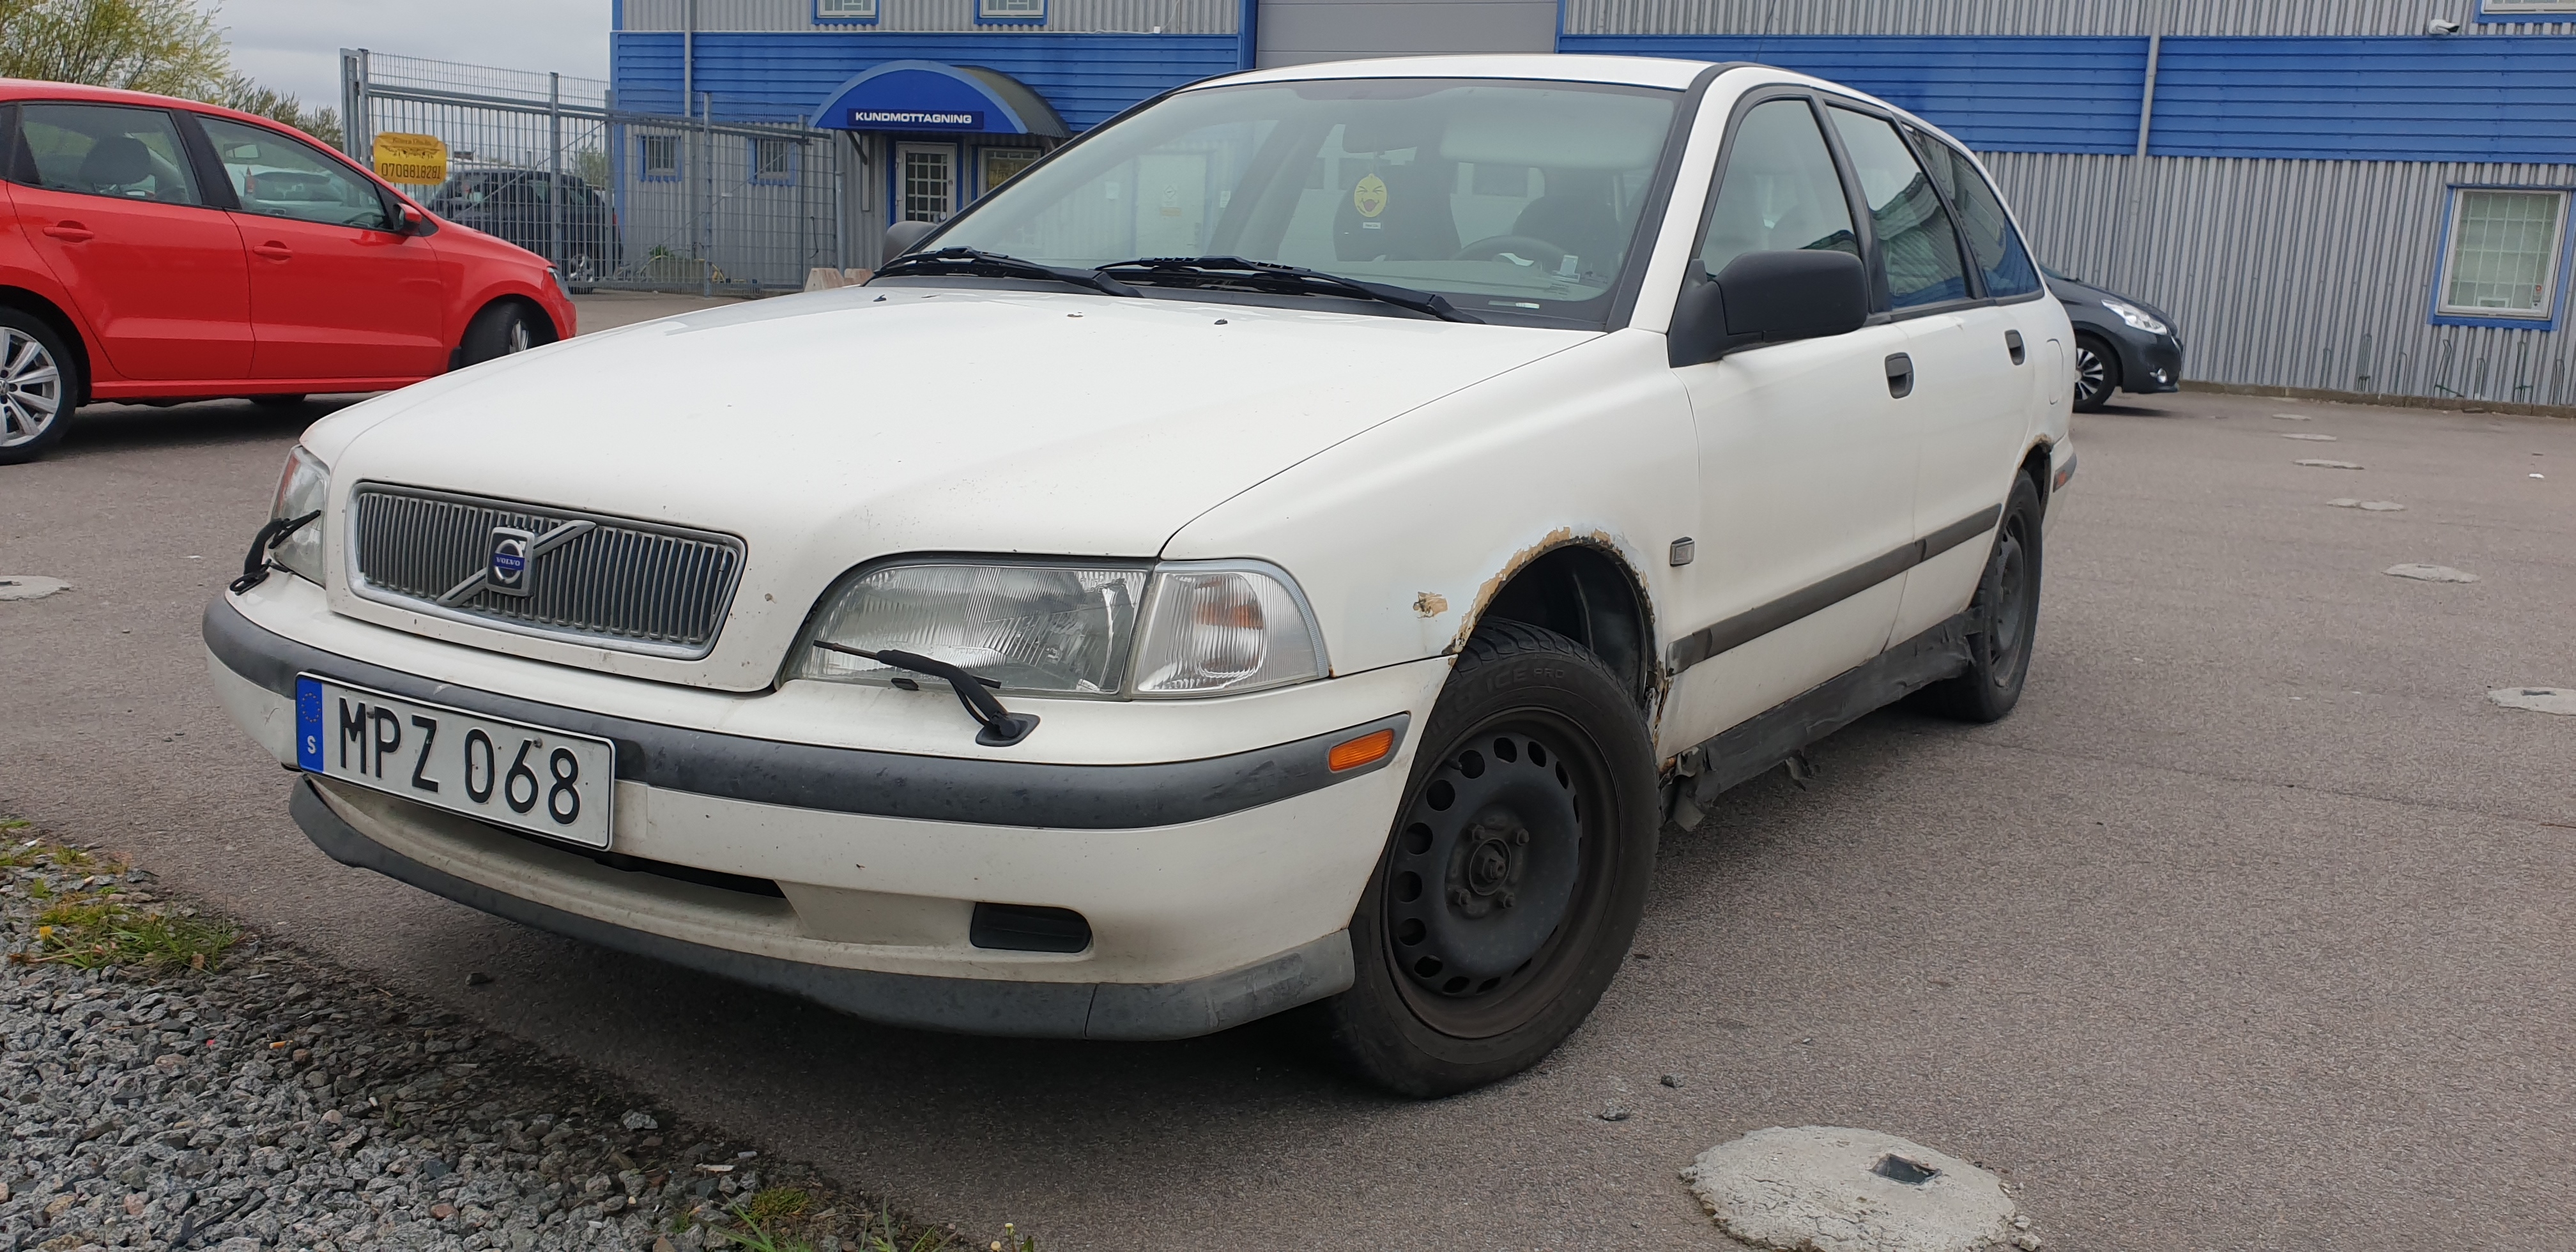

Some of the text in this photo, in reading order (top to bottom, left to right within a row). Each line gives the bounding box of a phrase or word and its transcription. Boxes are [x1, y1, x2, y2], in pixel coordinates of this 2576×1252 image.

[855, 112, 972, 123] KUNDMOTTAGNING
[381, 163, 441, 179] 0708818281
[496, 556, 521, 567] VOLVO
[1486, 668, 1528, 693] ICE
[307, 735, 317, 755] S
[339, 696, 581, 825] MPZ 068
